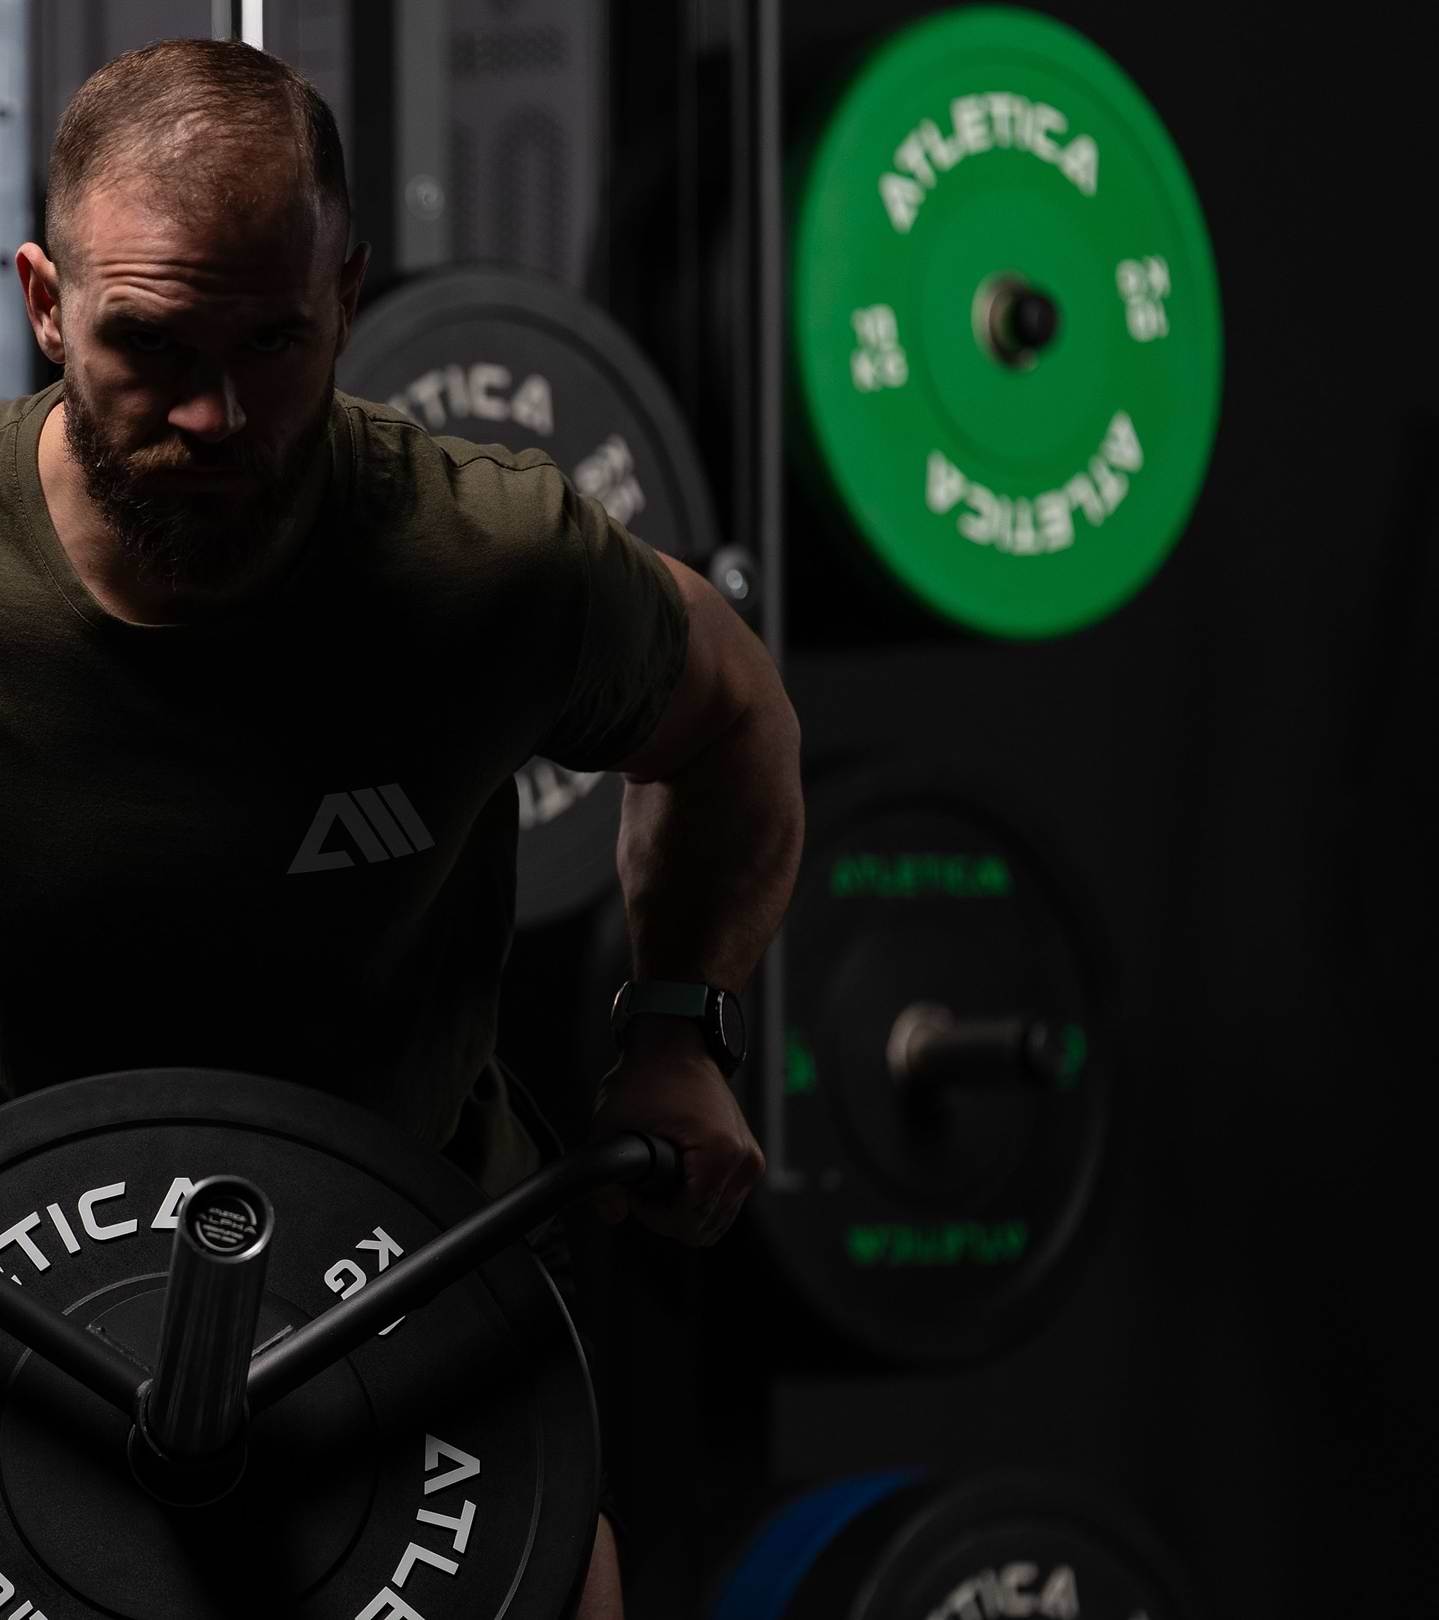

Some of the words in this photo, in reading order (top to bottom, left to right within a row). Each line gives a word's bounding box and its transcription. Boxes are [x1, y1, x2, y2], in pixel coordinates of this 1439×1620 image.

[878, 91, 1100, 235] ATLETICA
[389, 362, 554, 437] TICA
[925, 409, 1144, 557] ATLETICA
[324, 1226, 405, 1300] KG
[924, 1560, 1080, 1620] TICA
